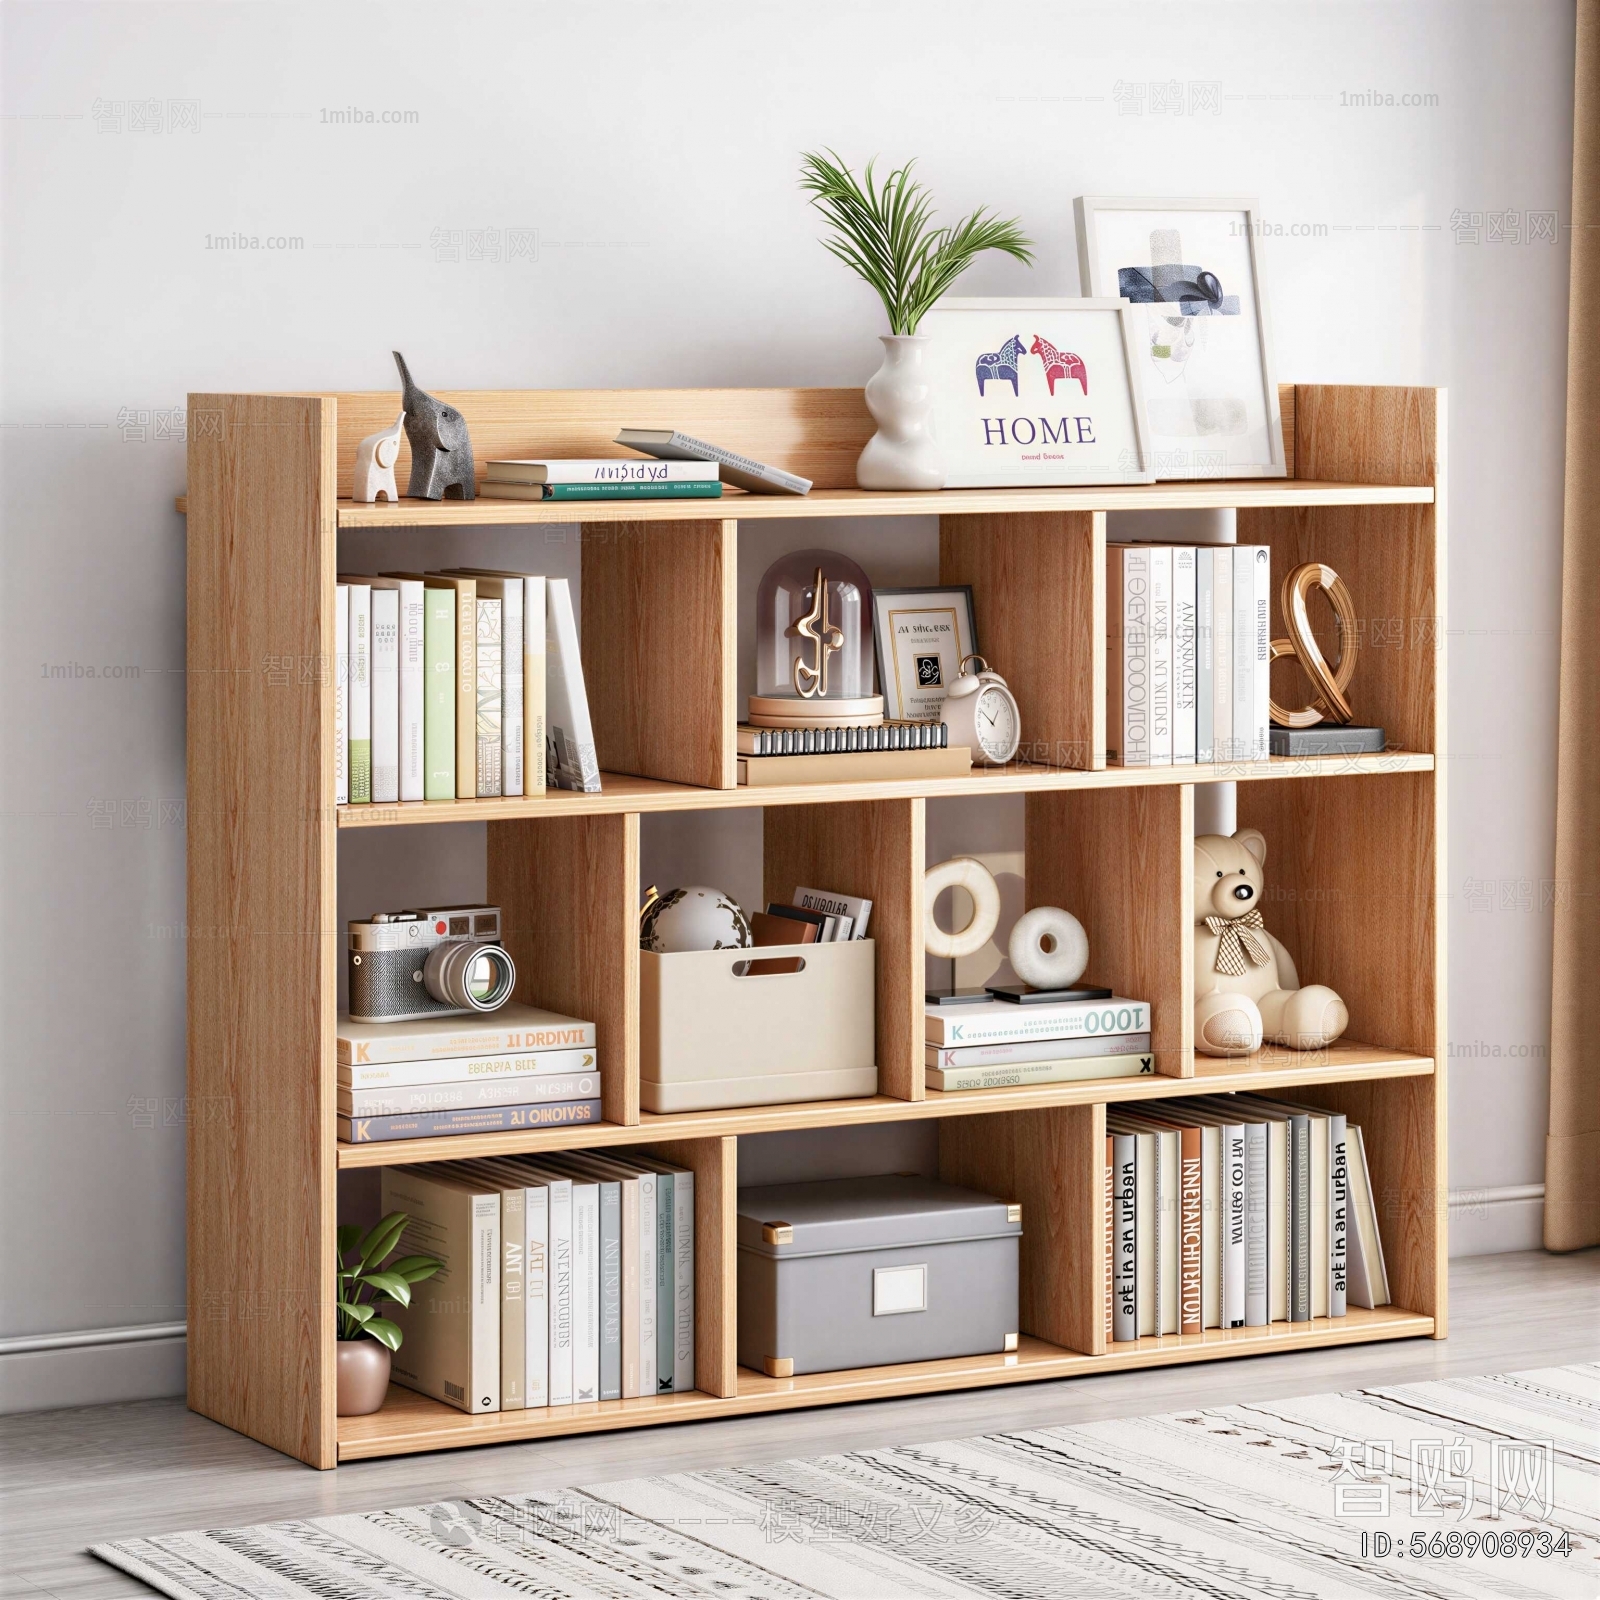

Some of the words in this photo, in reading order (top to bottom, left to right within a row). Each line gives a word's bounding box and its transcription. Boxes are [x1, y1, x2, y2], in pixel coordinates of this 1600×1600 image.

[980, 416, 1096, 446] HOME
[1084, 1007, 1144, 1034] 1000
[951, 1024, 964, 1041] K
[356, 1042, 372, 1063] K
[944, 1050, 956, 1067] K
[1139, 1057, 1152, 1074] X
[356, 1120, 372, 1141] K
